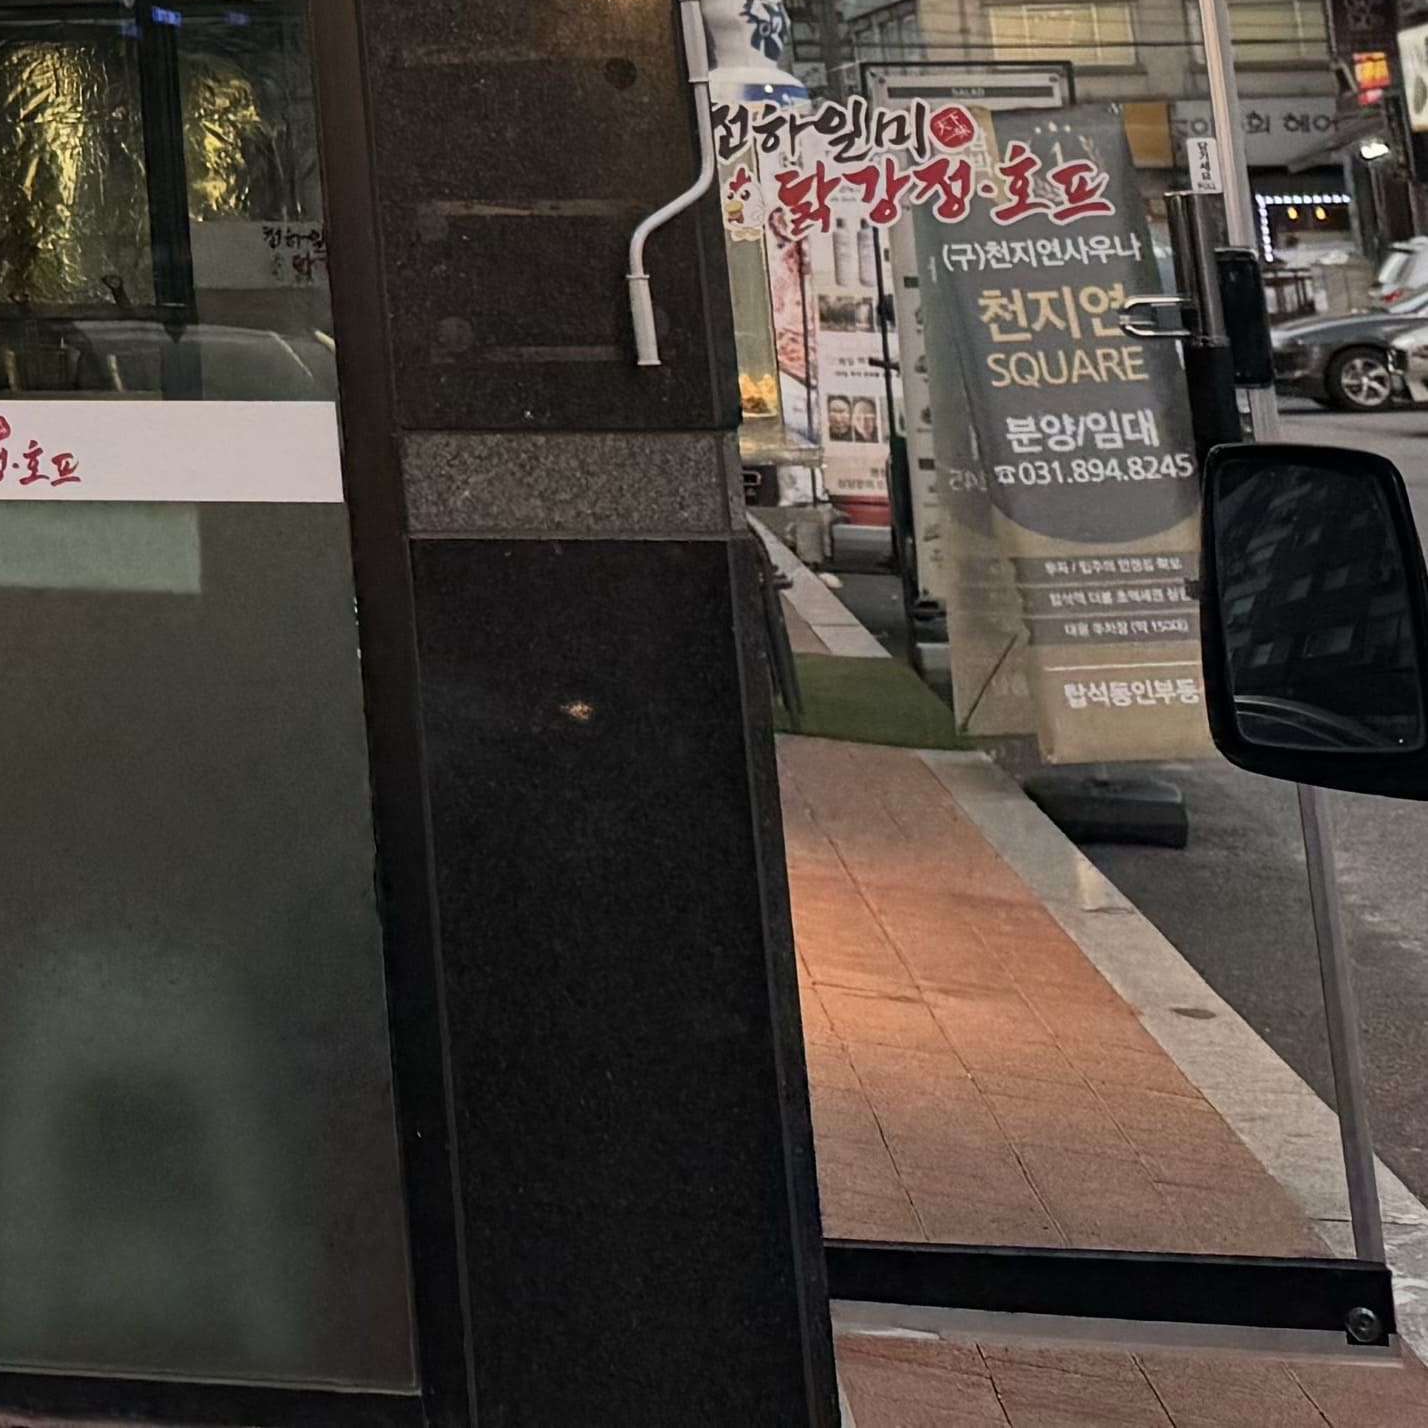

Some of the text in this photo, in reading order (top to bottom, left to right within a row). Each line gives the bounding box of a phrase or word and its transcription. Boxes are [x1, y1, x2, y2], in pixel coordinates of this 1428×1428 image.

[942, 232, 1142, 272] (구)천지연사우나
[977, 281, 1127, 343] 천지연
[986, 345, 1150, 389] SQUARE
[1005, 408, 1160, 454] 분양/임대
[1017, 453, 1194, 485] 031.894.8245
